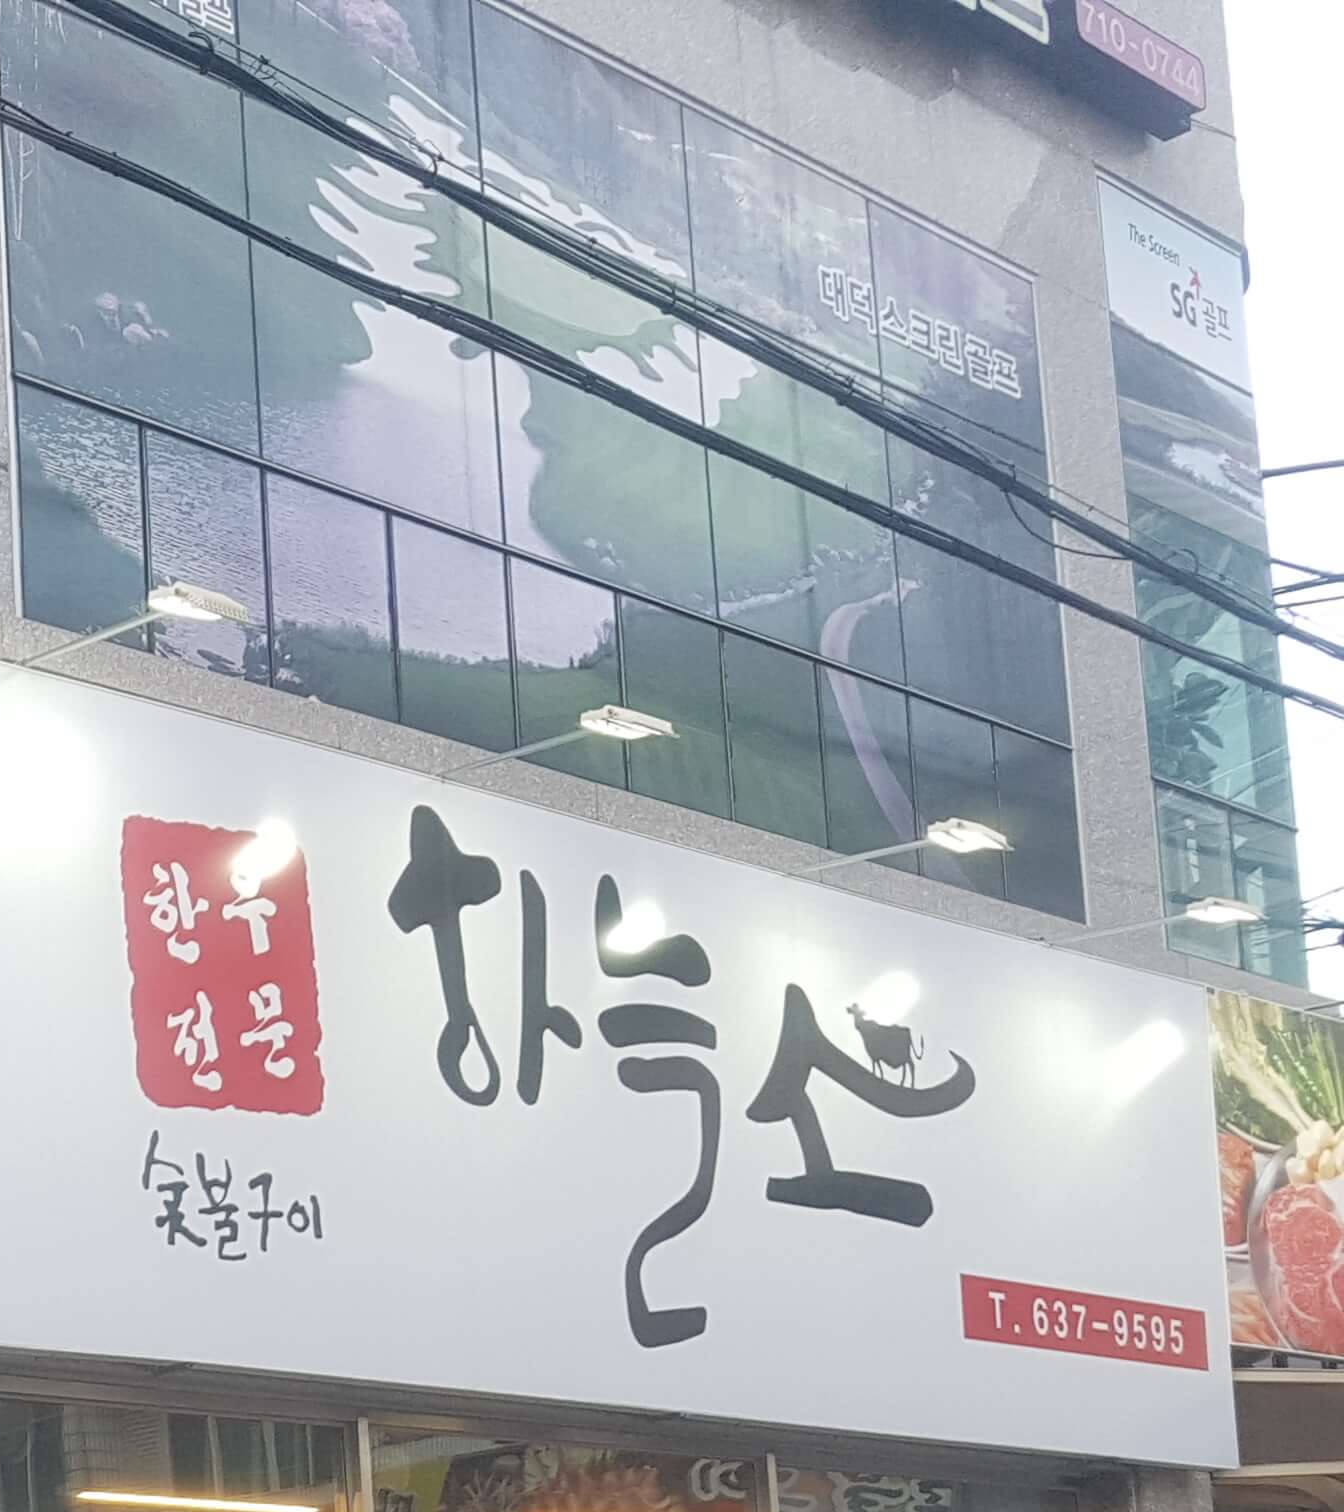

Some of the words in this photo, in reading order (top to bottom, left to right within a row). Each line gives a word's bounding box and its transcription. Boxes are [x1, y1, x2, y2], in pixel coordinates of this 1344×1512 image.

[1084, 1, 1200, 98] 710-0744
[1127, 223, 1147, 247] The
[1148, 233, 1180, 267] Screen
[1169, 282, 1197, 327] SG
[1202, 300, 1233, 342] 골프
[143, 862, 280, 965] 한우
[165, 984, 296, 1092] 전문
[387, 804, 978, 1350] 하늘소
[141, 1130, 325, 1263] 숯불구이
